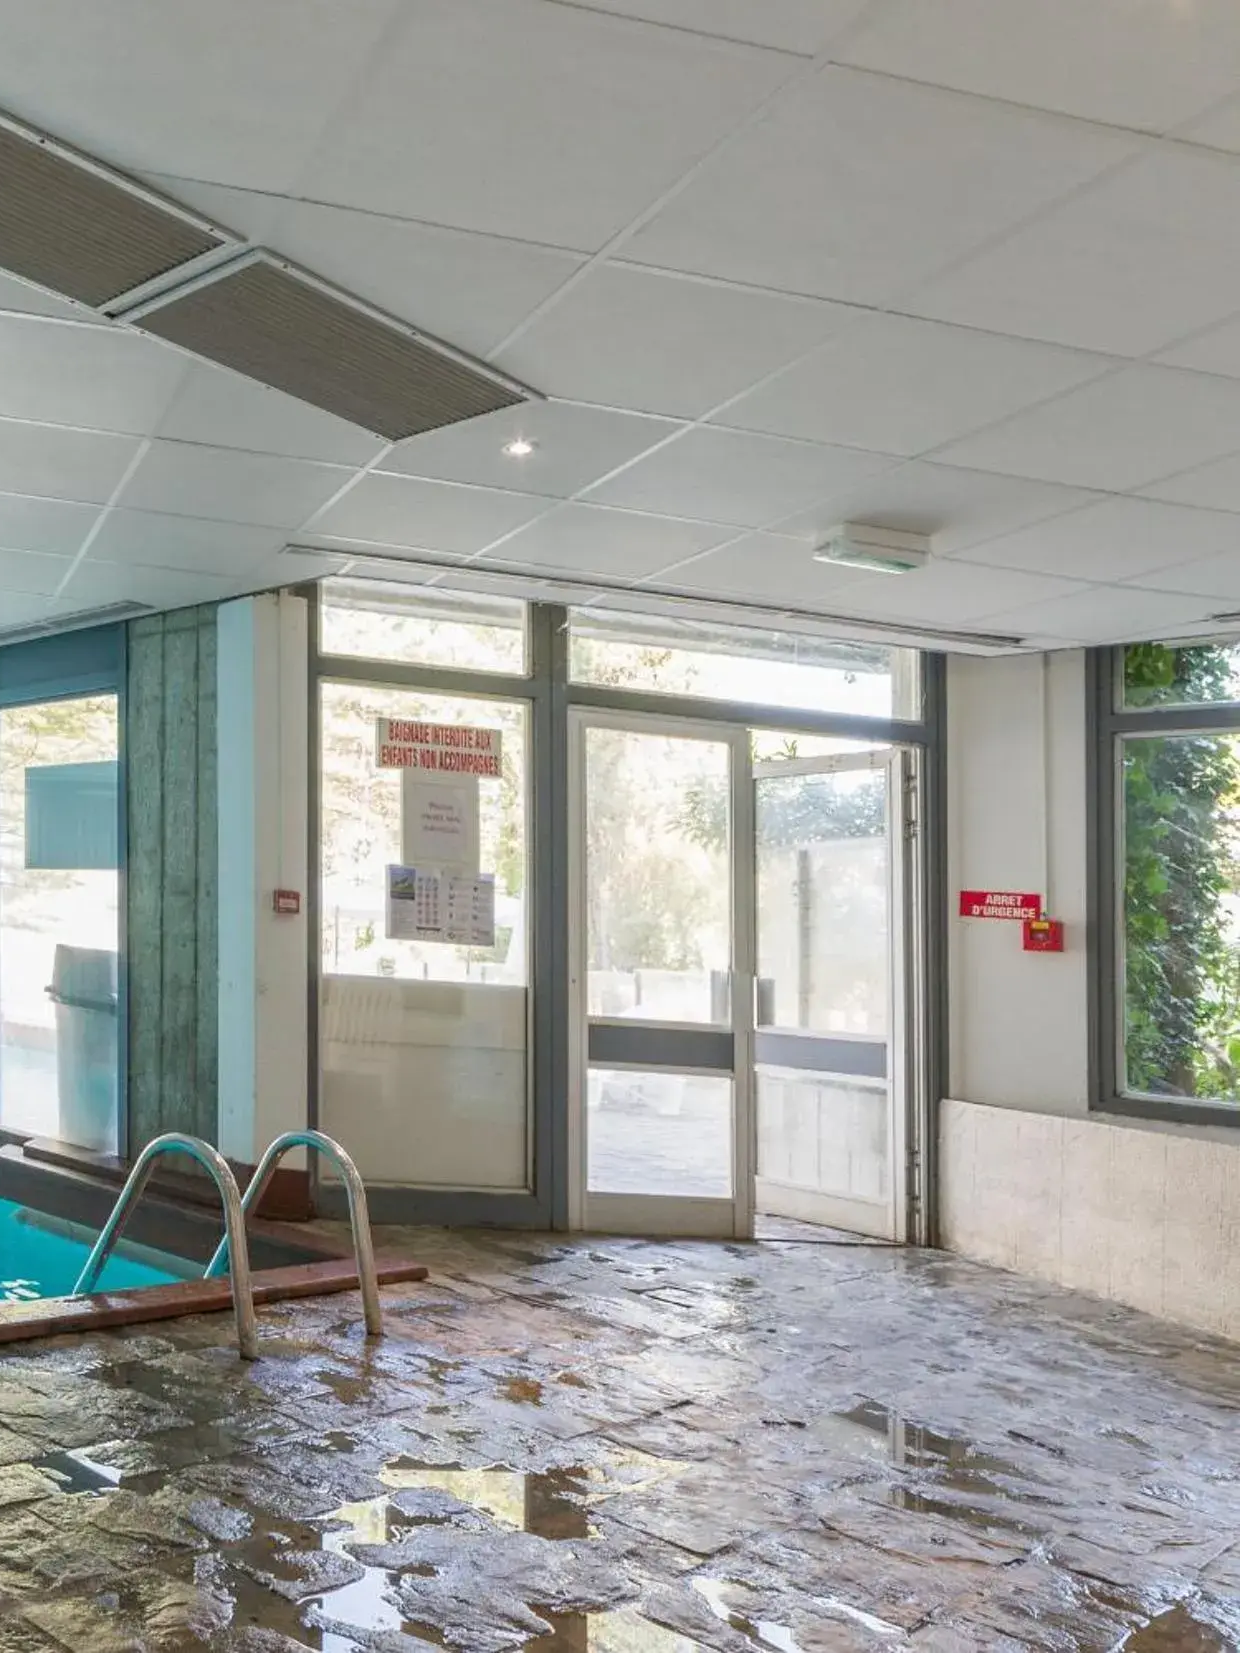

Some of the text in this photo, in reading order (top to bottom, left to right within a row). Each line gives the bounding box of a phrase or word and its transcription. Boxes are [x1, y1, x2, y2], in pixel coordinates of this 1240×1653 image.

[475, 729, 492, 750] AUX
[381, 745, 418, 767] ENFANTS
[420, 748, 437, 769] NON
[985, 894, 1023, 906] ARRET
[972, 905, 1036, 918] D'URGENCE
